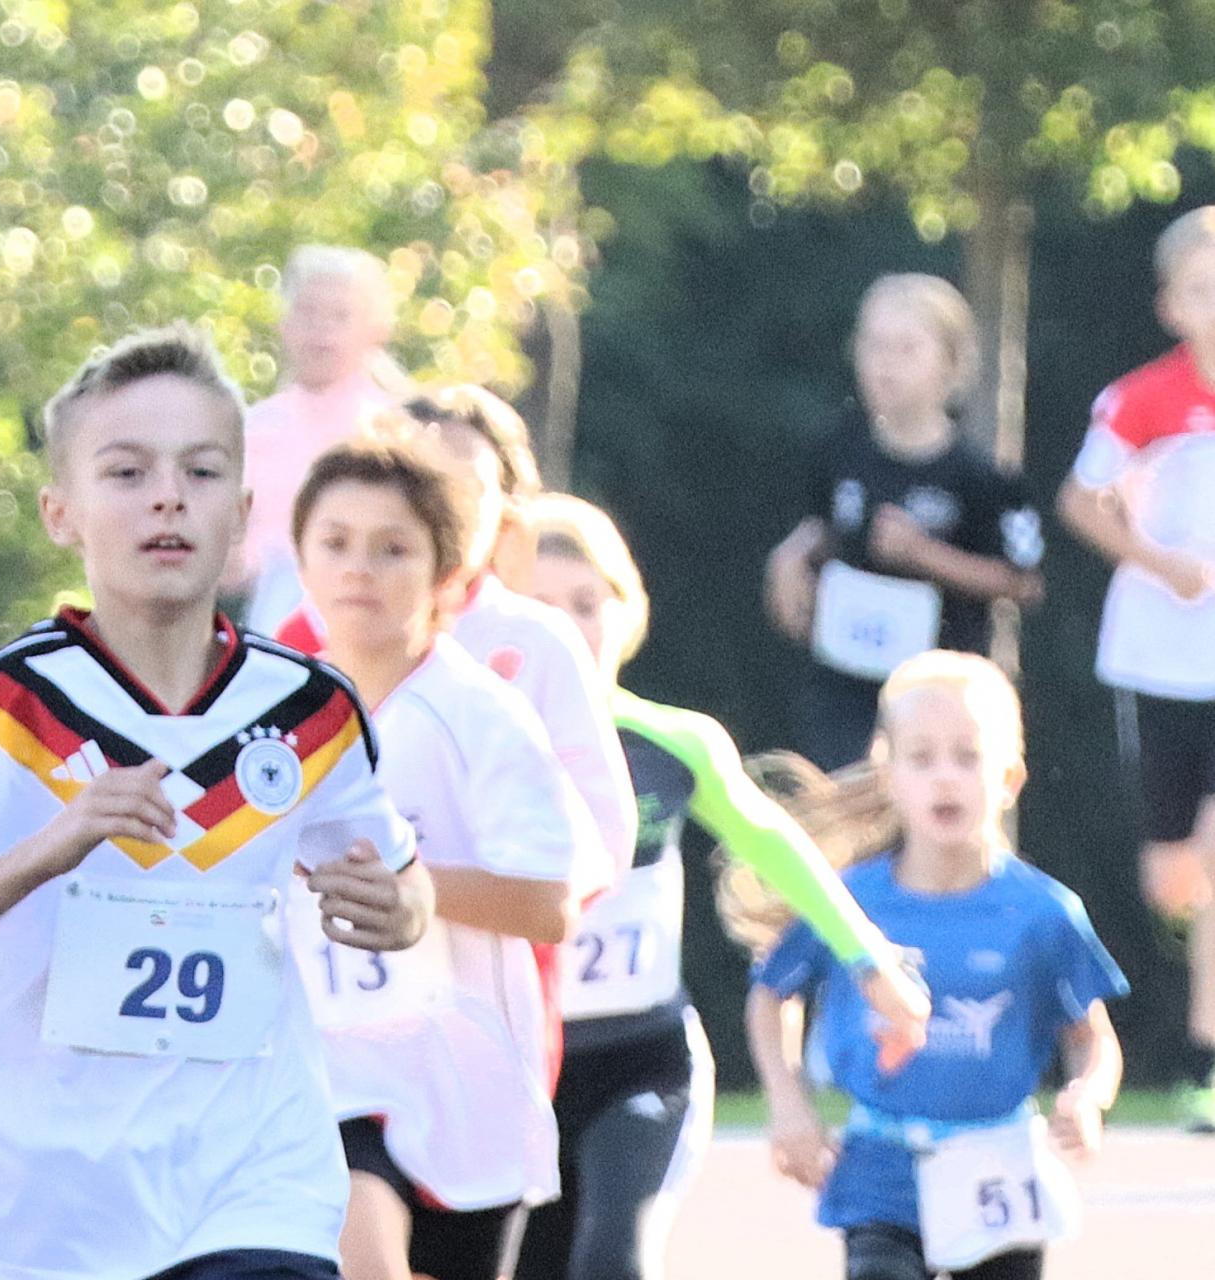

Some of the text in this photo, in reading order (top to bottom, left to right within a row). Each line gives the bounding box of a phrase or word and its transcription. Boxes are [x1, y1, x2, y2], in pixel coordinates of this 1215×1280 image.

[314, 943, 389, 994] 13
[574, 928, 644, 983] 27
[119, 946, 225, 1022] 29
[977, 1178, 1043, 1229] 51
